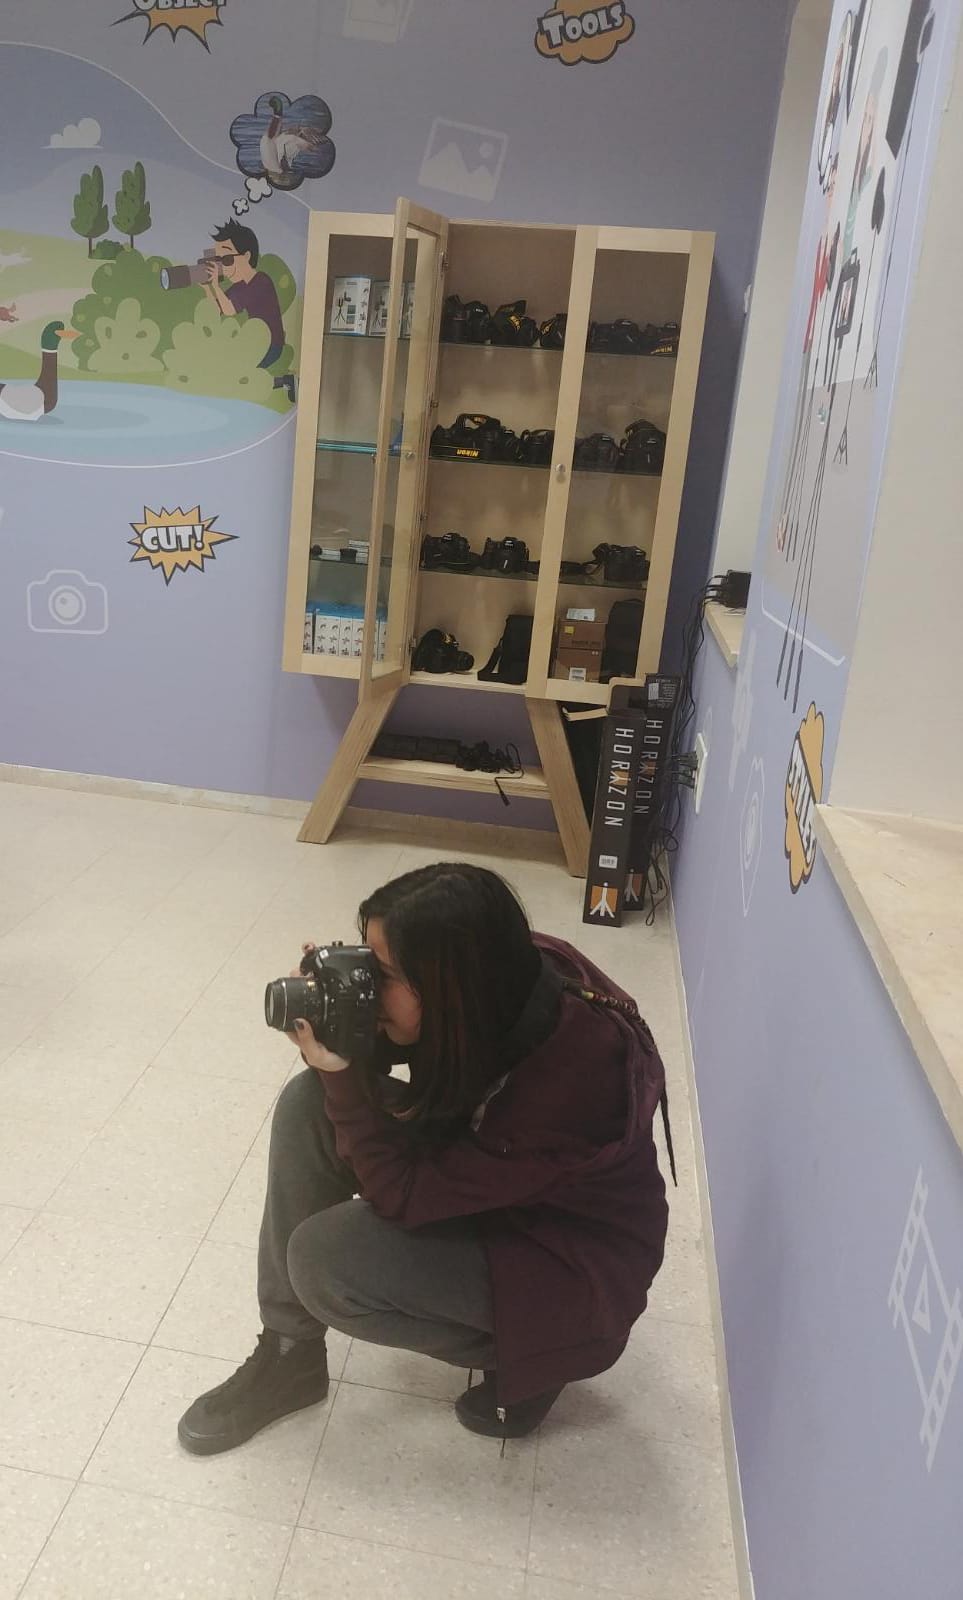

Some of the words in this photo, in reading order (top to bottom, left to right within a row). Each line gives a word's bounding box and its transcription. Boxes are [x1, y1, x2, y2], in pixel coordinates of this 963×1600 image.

[540, 4, 624, 47] TOOLS
[142, 525, 205, 552] CUT!
[604, 728, 635, 826] HORIZON
